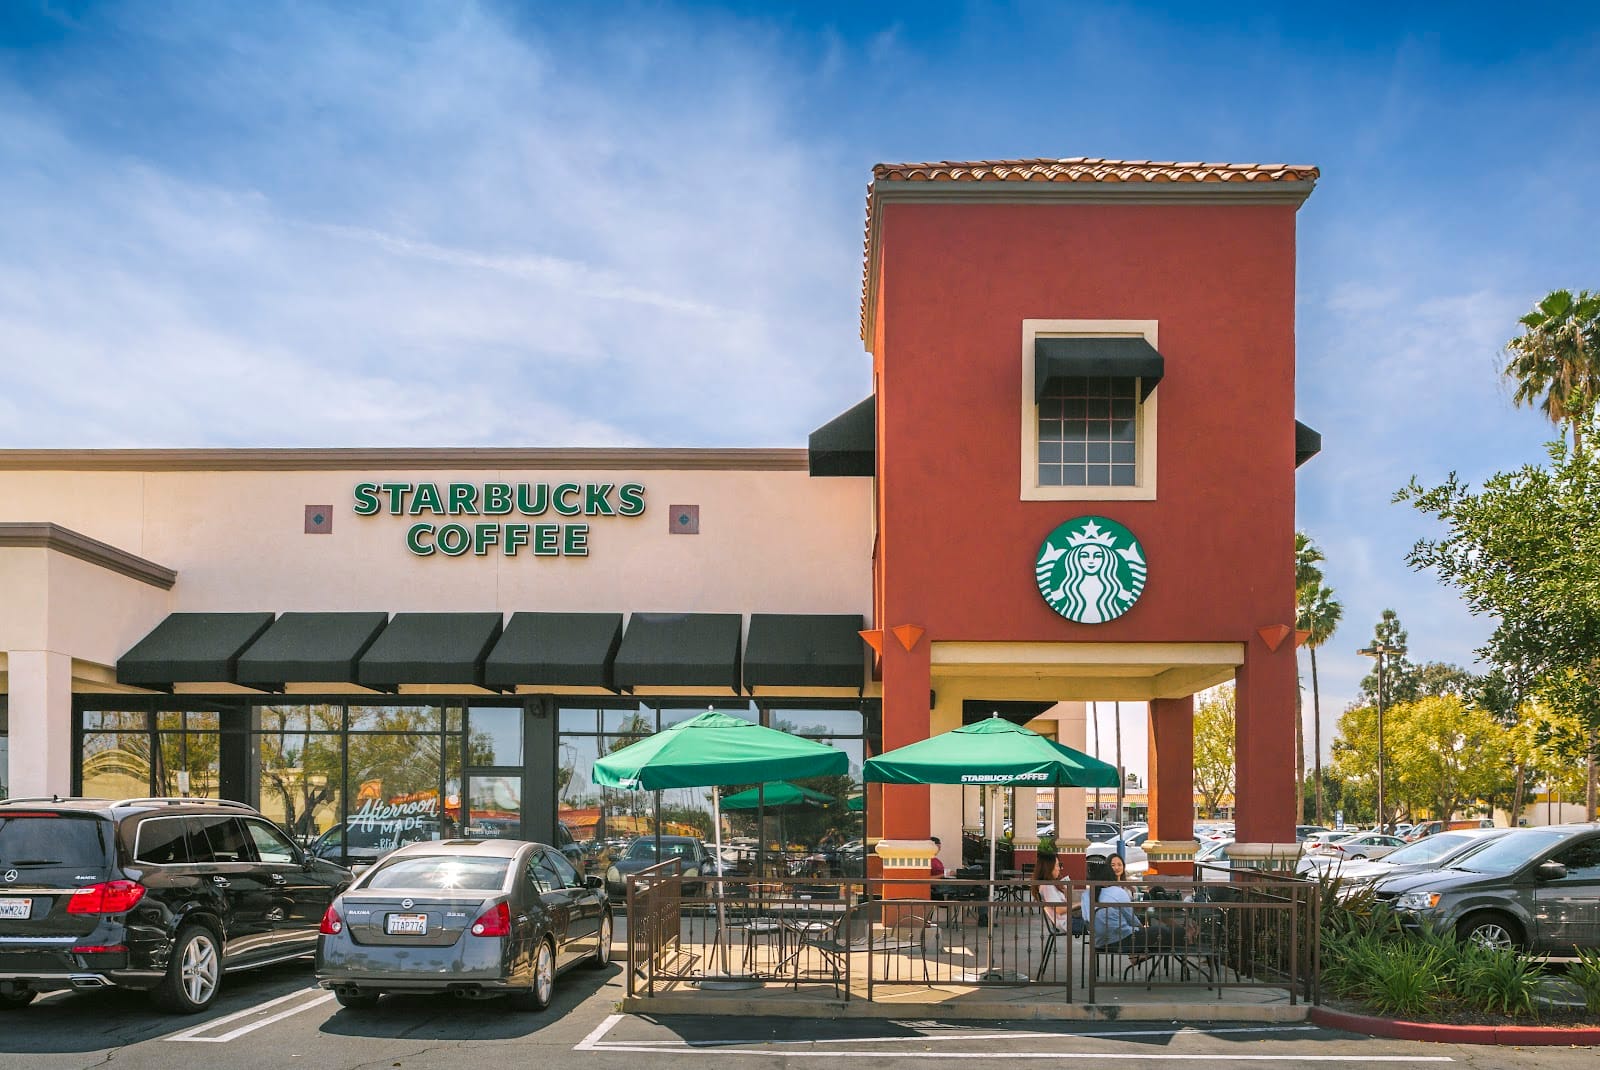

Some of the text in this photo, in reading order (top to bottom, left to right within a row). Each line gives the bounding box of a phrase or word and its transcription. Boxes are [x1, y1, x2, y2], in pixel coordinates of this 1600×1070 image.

[353, 482, 647, 517] STARBUCKS
[405, 522, 590, 556] COFFEE
[961, 772, 1049, 782] STARBUCKS COFFEE
[346, 798, 438, 833] Afternoon
[380, 815, 426, 835] MADE
[391, 921, 424, 931] 7TAP776
